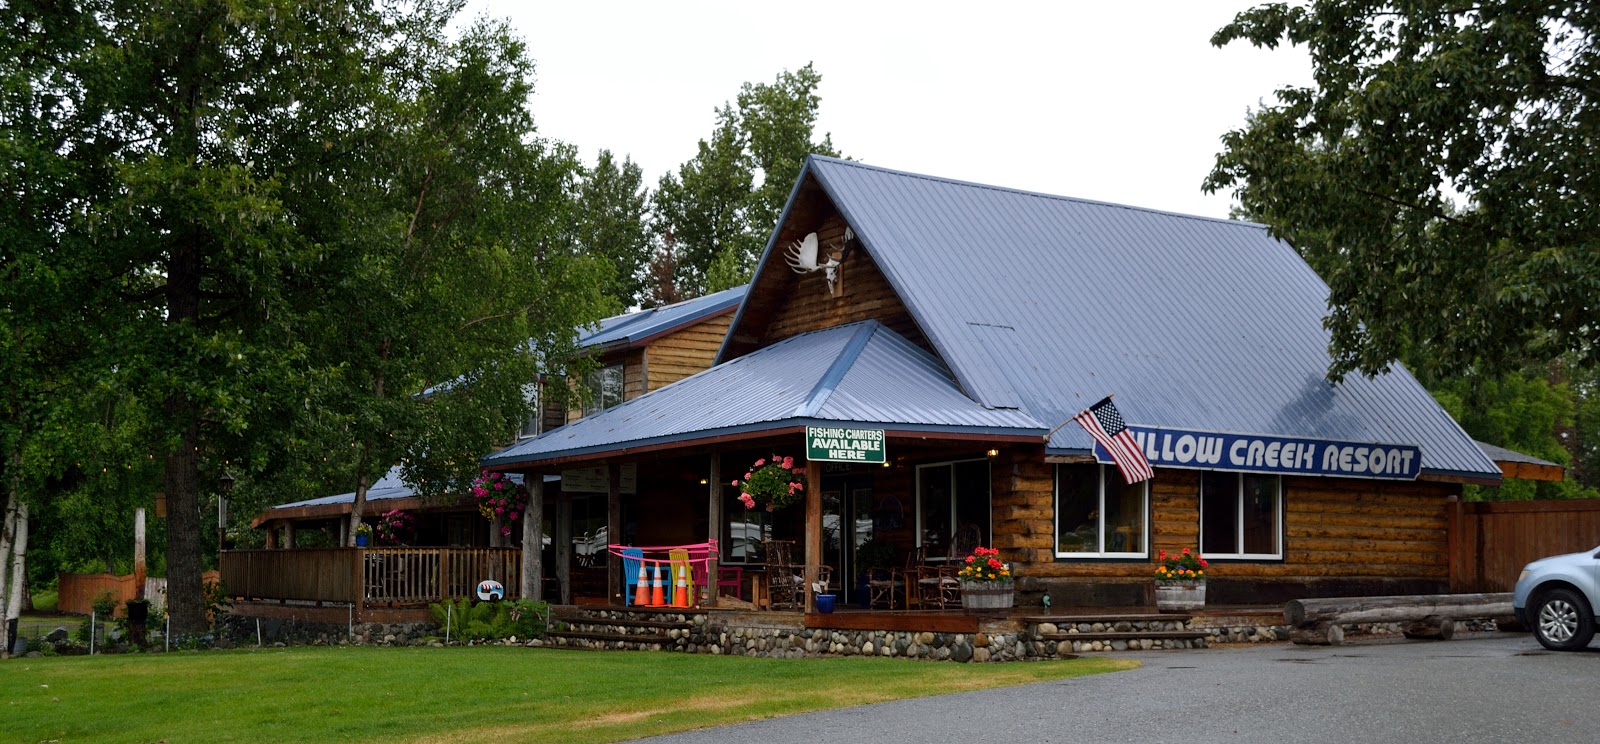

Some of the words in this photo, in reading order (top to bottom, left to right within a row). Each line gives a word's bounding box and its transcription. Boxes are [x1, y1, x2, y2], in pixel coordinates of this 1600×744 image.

[808, 427, 845, 438] FISHING
[845, 429, 882, 440] CHARTERS
[811, 438, 880, 450] AVAILABLE
[828, 450, 866, 460] HERE
[1129, 431, 1223, 464] ILLOW
[1229, 439, 1315, 469] CREEK
[1322, 444, 1414, 475] RESORT
